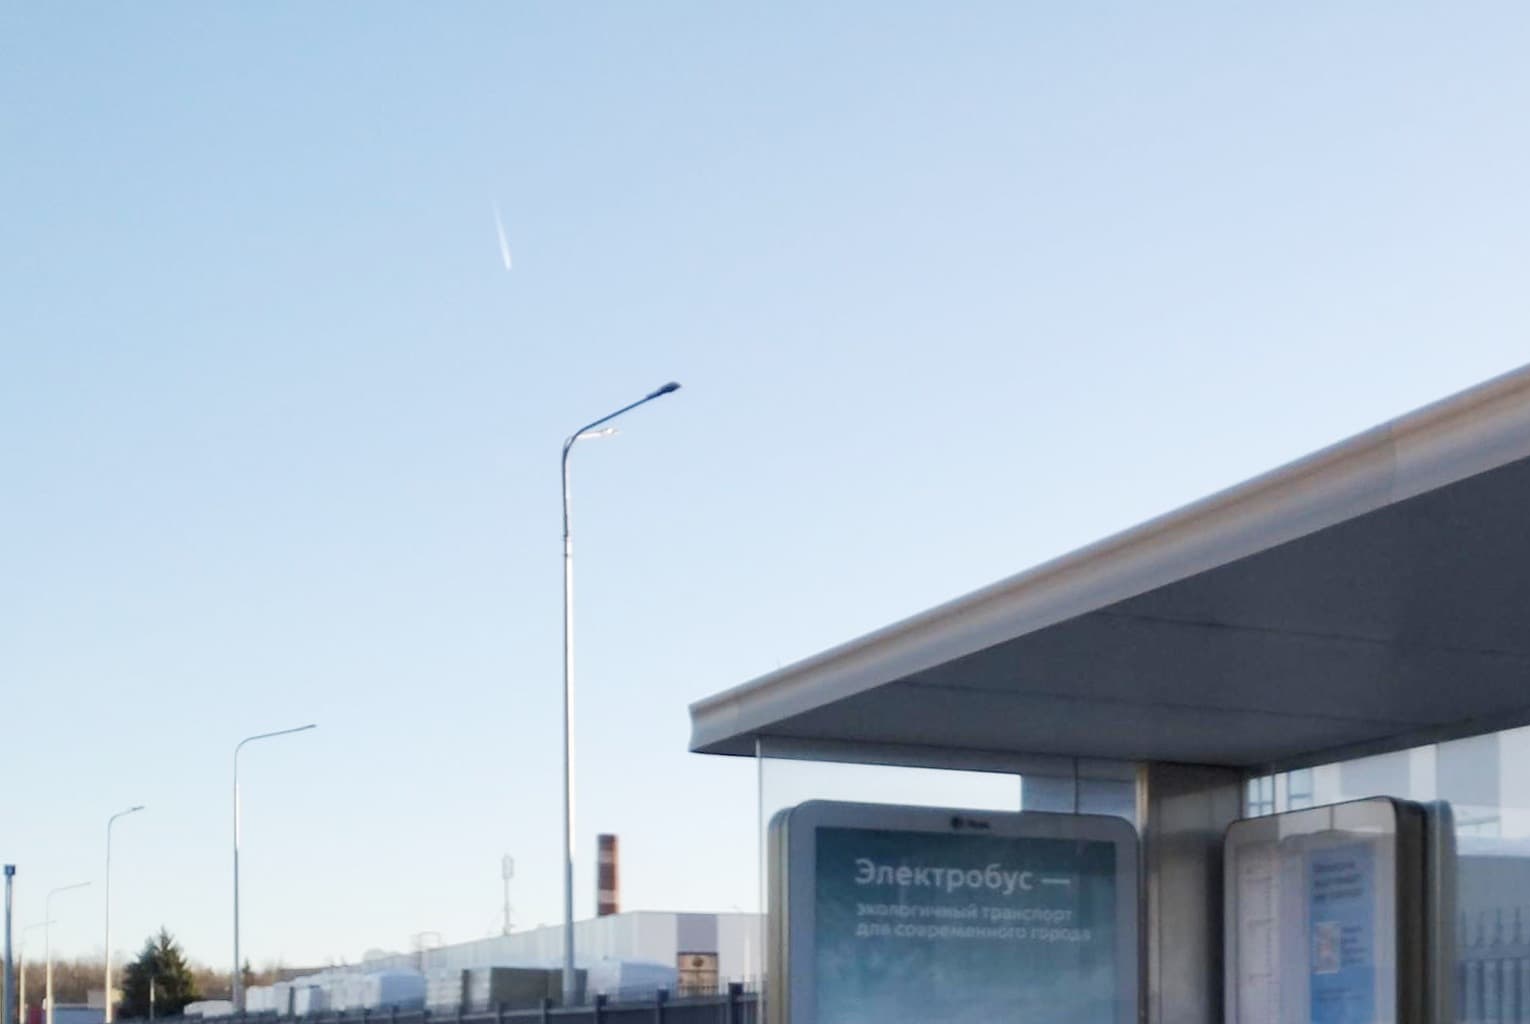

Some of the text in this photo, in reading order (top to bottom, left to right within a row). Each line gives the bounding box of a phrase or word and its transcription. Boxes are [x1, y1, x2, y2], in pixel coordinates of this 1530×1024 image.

[854, 857, 1033, 895] Электробус
[856, 903, 1072, 923] экологичный транспорт
[855, 921, 1092, 944] для современного города
